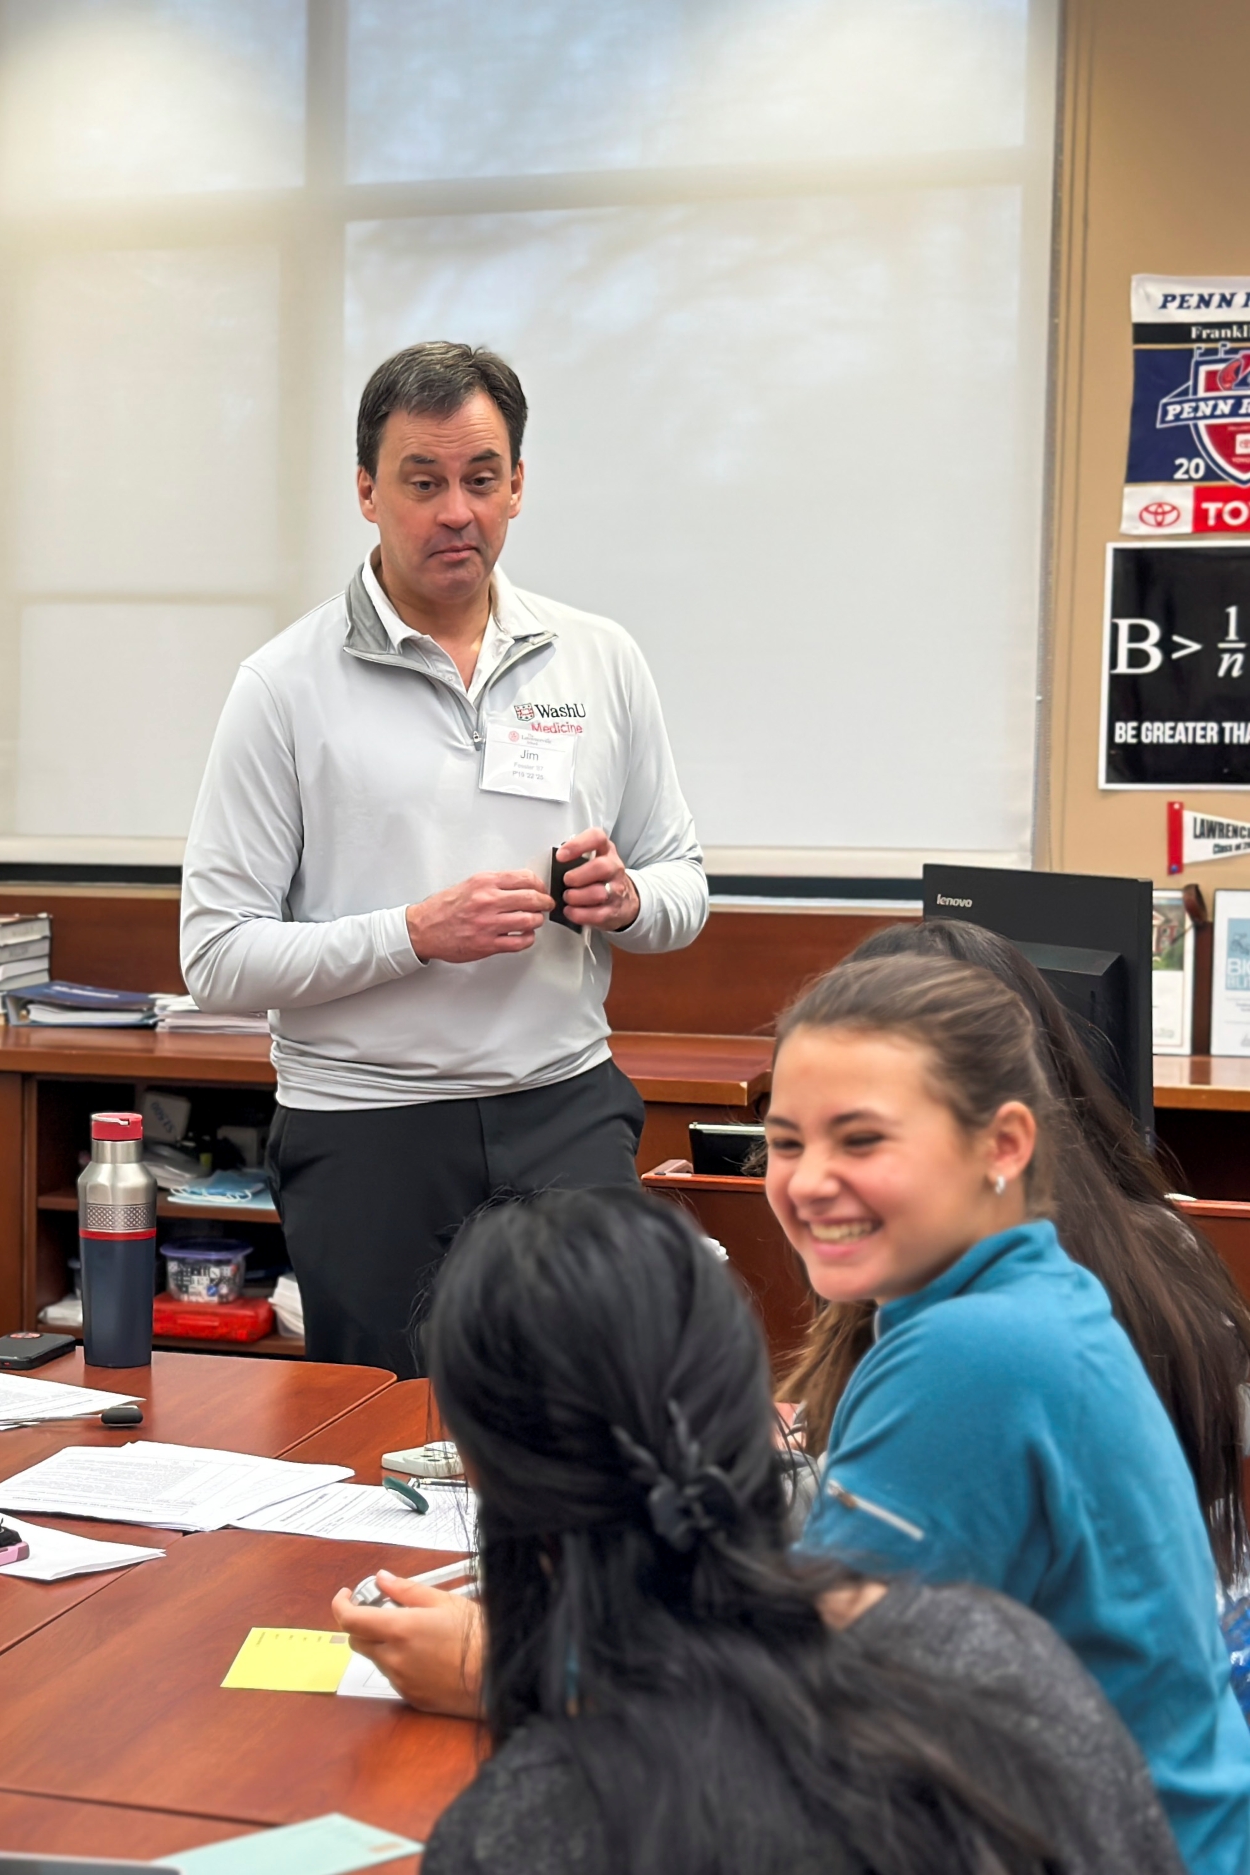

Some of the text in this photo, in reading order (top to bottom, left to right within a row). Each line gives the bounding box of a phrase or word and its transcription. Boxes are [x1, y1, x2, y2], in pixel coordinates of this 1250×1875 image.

[1158, 292, 1237, 310] PENN
[1191, 324, 1250, 339] Frankl
[1165, 399, 1235, 421] PENN
[1173, 457, 1205, 479] 20
[1201, 500, 1250, 527] TO
[1110, 618, 1163, 674] B
[1217, 652, 1244, 678] n
[534, 703, 586, 718] WashU
[531, 722, 583, 733] Medicine
[1114, 721, 1138, 743] BE
[1141, 721, 1219, 744] GREATER
[520, 749, 539, 761] Jim
[936, 893, 973, 908] lenovo
